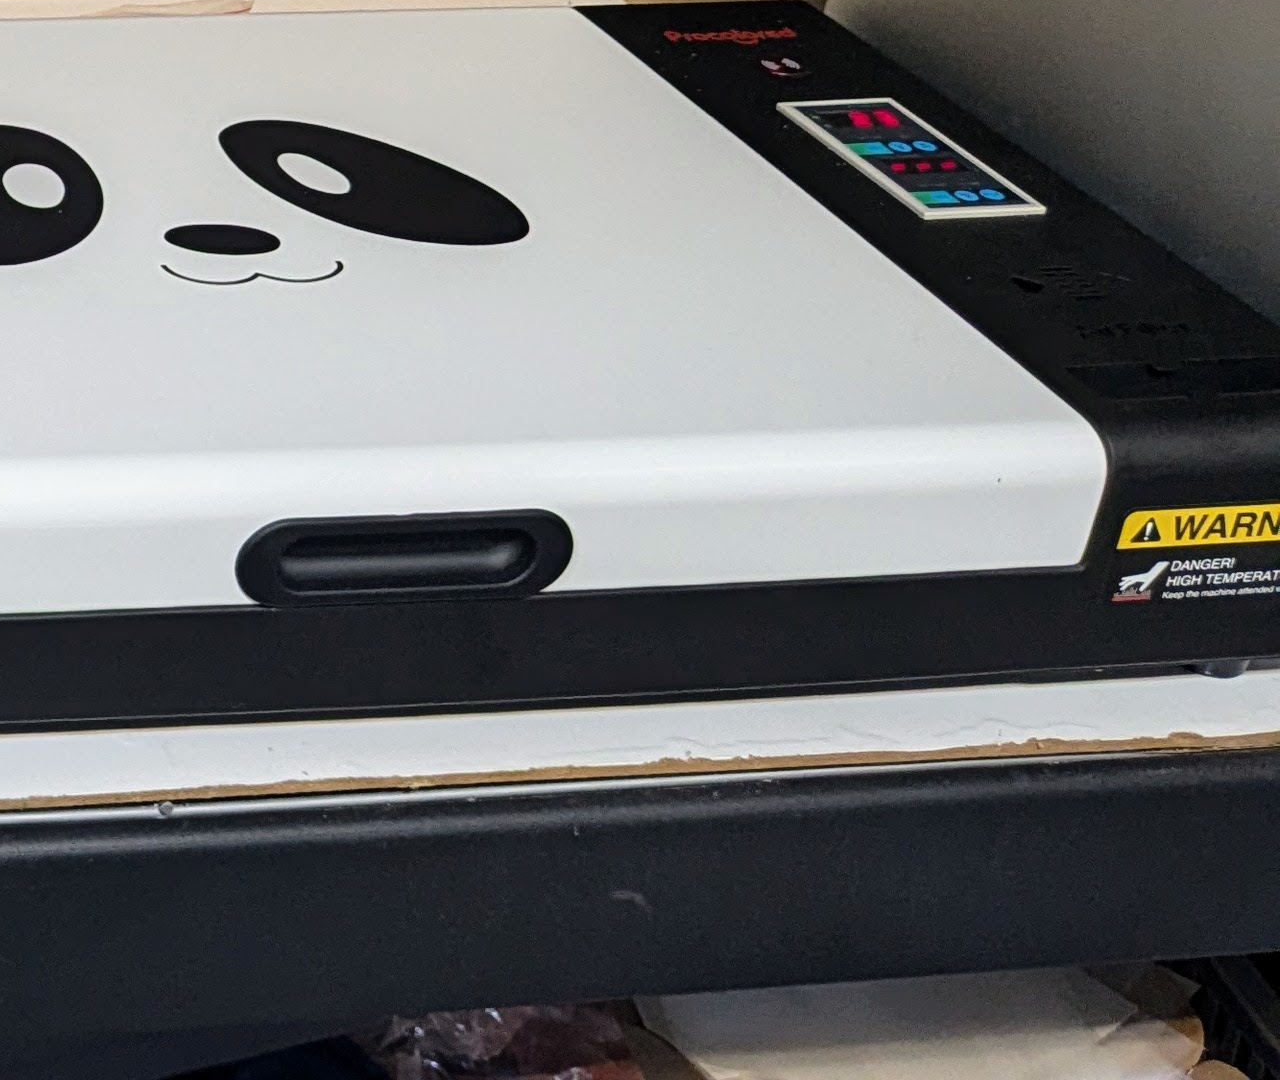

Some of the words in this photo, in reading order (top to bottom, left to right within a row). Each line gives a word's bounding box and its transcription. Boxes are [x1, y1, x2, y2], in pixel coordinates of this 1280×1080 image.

[663, 27, 797, 43] Procolored
[1175, 511, 1280, 540] WARN
[1170, 558, 1236, 572] DANGER!
[1165, 574, 1203, 587] HIGH
[1206, 570, 1280, 585] TEMPERAT
[1162, 591, 1184, 599] Keep
[1201, 588, 1236, 597] machine
[1237, 586, 1275, 595] attended
